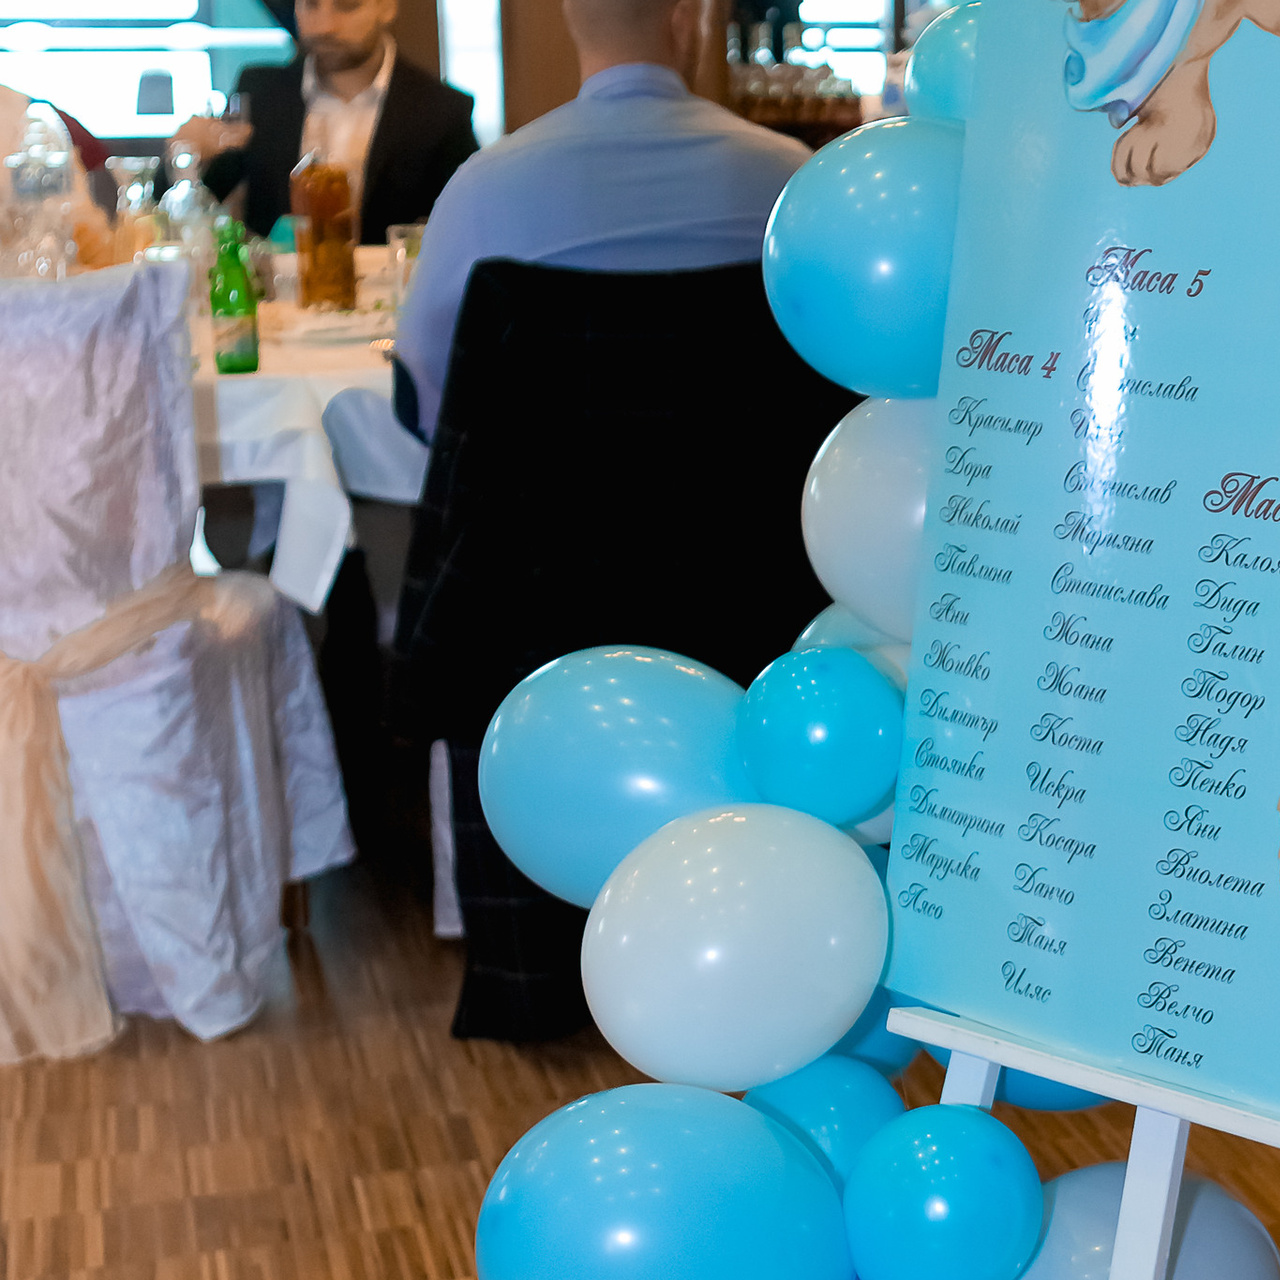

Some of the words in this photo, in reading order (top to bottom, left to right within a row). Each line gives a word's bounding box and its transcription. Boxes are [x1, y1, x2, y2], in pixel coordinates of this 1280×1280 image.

[1186, 268, 1212, 298] 5
[956, 329, 1035, 377] Маса
[1040, 351, 1062, 380] 4
